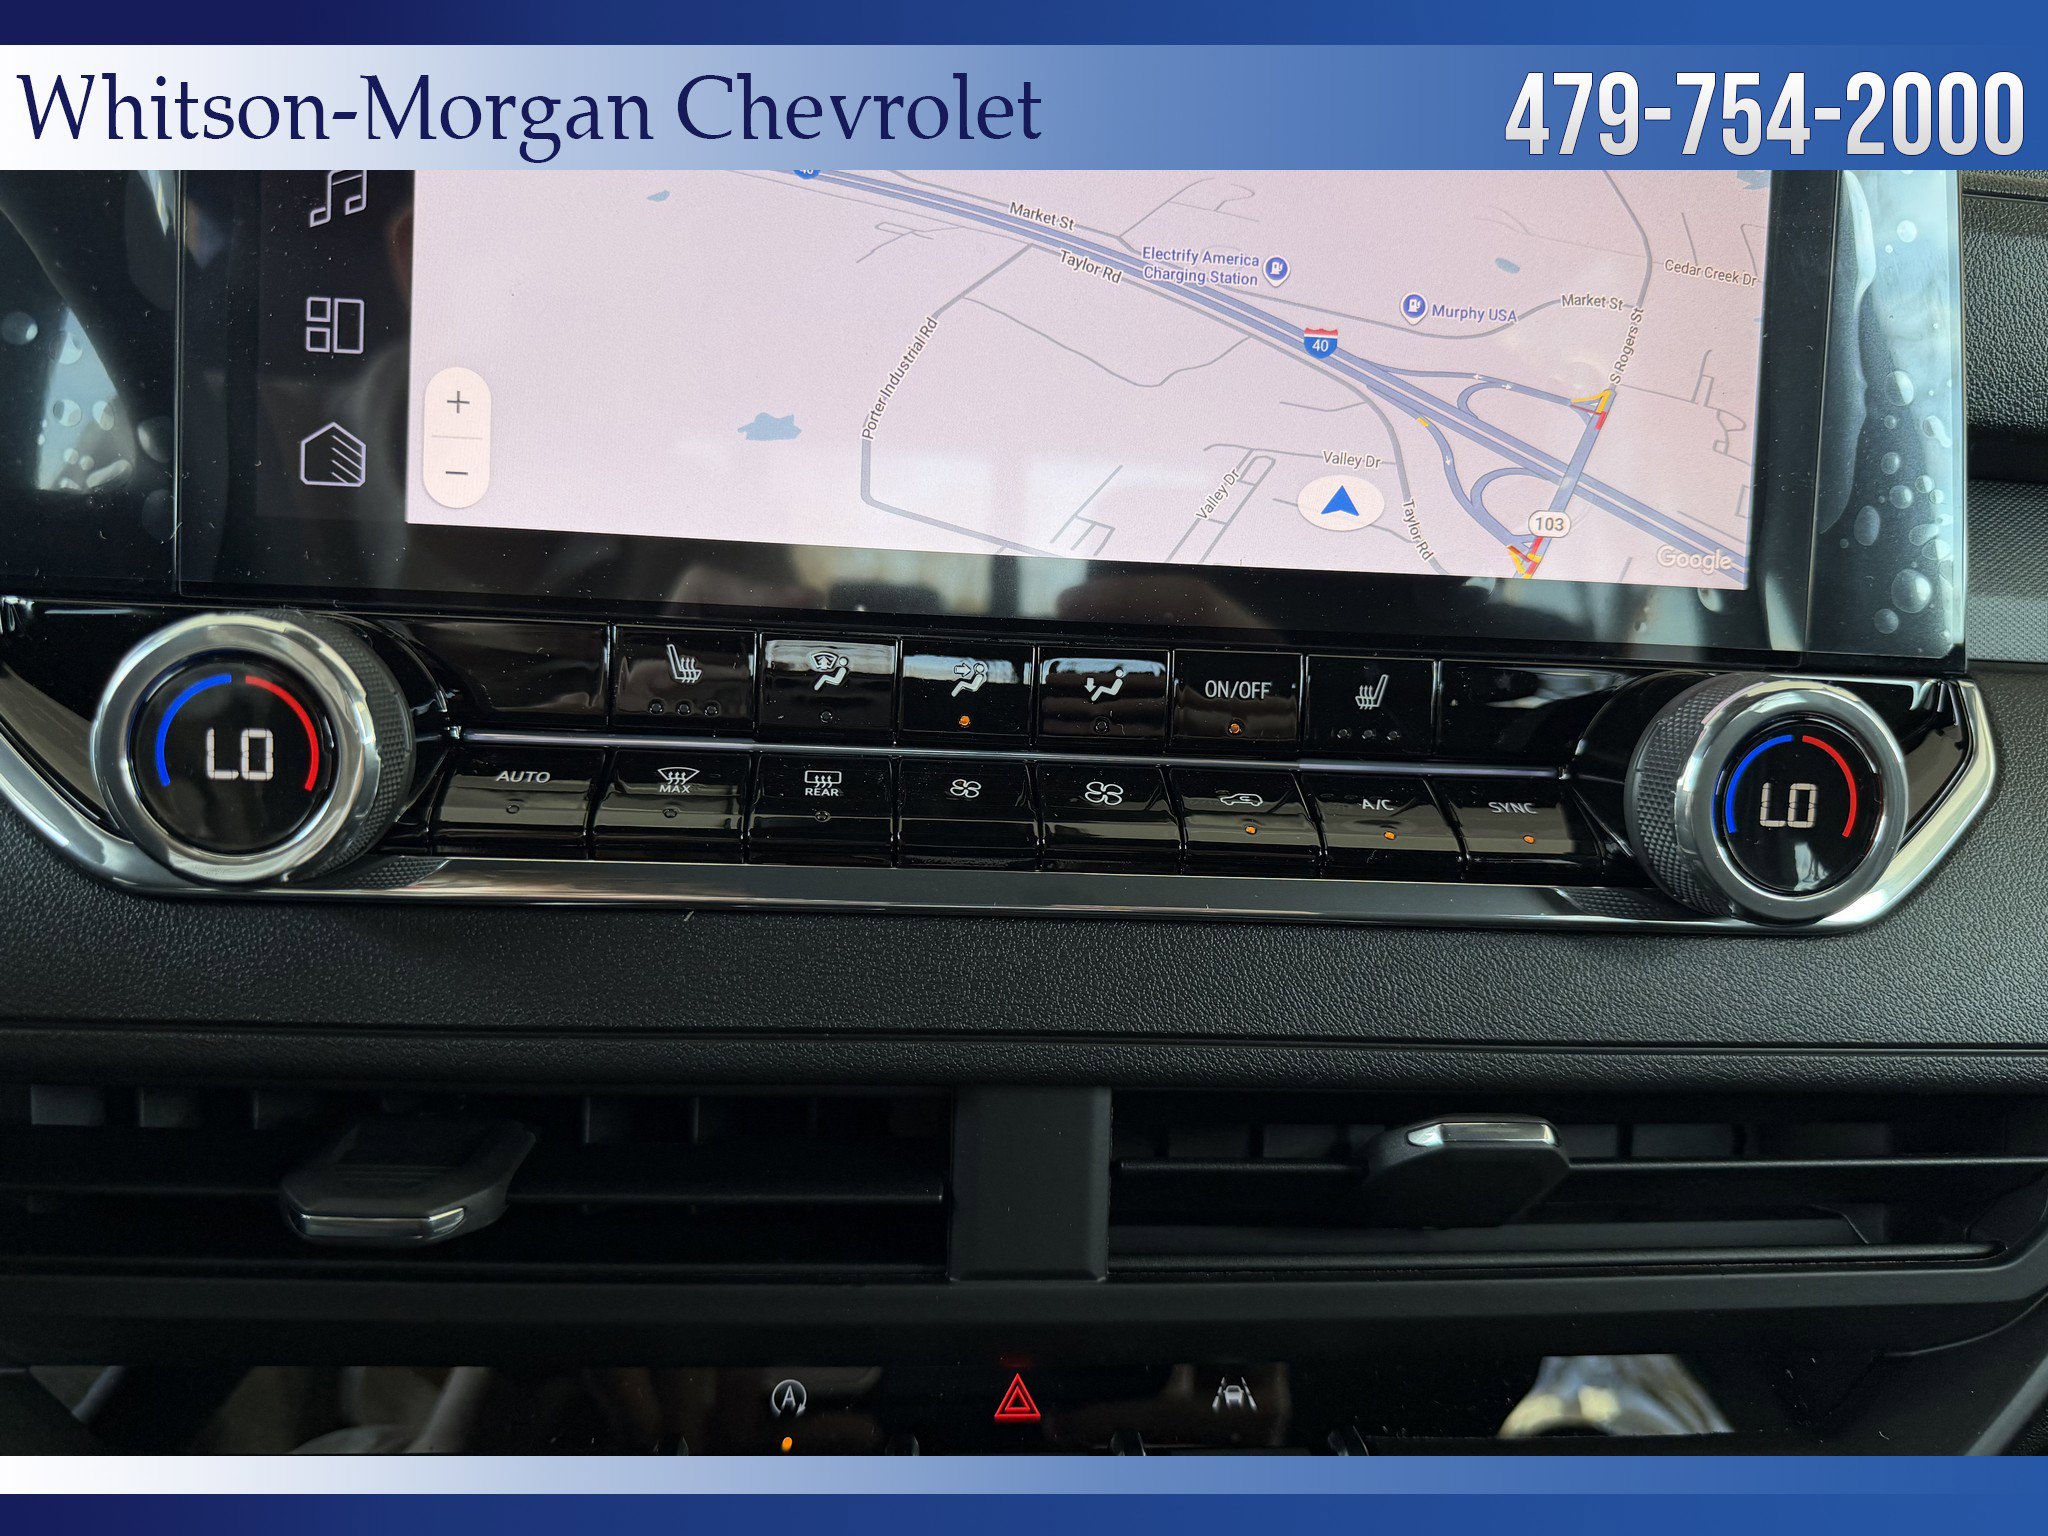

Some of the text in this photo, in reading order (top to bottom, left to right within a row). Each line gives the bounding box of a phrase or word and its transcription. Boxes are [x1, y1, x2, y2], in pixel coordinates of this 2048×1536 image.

[1009, 202, 1075, 231] Market St
[1060, 249, 1121, 283] Taylor Rd
[1142, 247, 1259, 267] Electrify America
[1143, 266, 1258, 287] Charging Station
[1665, 260, 1757, 288] Cedar Creek Dr
[1561, 293, 1624, 312] Market St
[1431, 304, 1517, 323] Murphy USA
[1312, 338, 1329, 352] 40
[1611, 307, 1643, 384] S Rogers St
[861, 316, 938, 440] Porter Industrial Rd
[1323, 451, 1381, 469] Valley Dr
[1196, 468, 1240, 521] Valley Dr
[1404, 499, 1433, 561] Taylor Rd
[1535, 516, 1565, 533] 103
[1657, 544, 1733, 574] Google
[1204, 680, 1272, 700] ON/OFF
[206, 727, 274, 782] LO
[496, 770, 551, 785] AUTO
[659, 783, 692, 794] MAX
[804, 788, 840, 797] REAR
[1361, 797, 1394, 812] A/C
[1488, 800, 1538, 816] SYNC
[1759, 782, 1817, 830] LO
